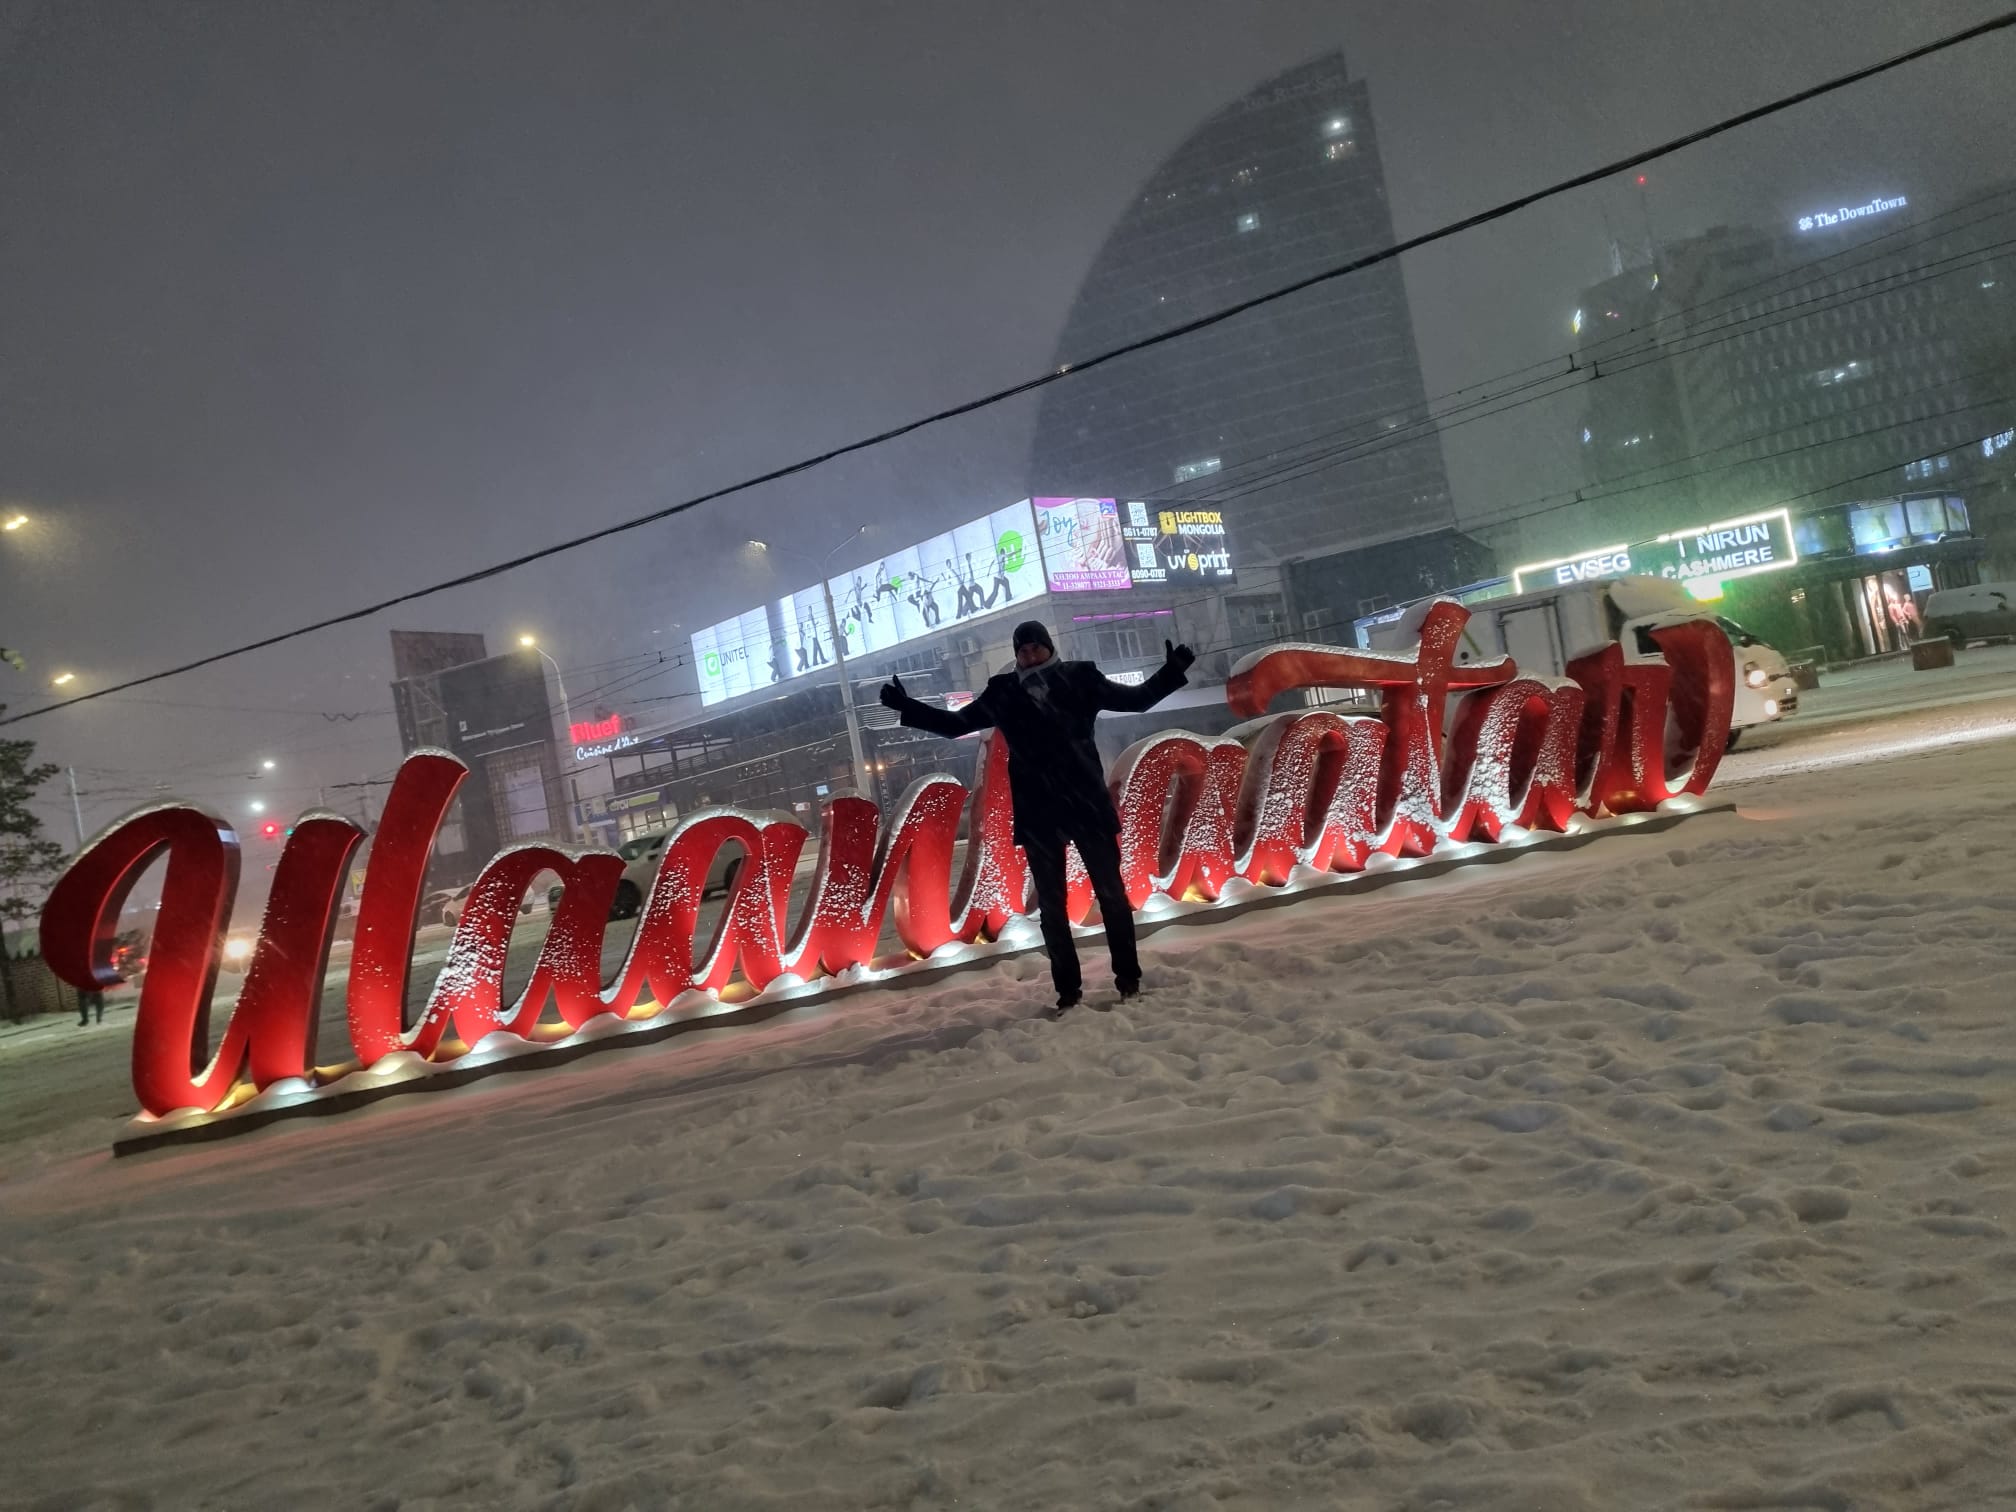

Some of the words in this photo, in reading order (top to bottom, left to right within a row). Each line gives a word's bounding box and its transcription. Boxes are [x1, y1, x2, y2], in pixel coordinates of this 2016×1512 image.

[1815, 213, 1838, 227] The
[1838, 196, 1907, 221] DownTown
[1040, 510, 1078, 547] Joy
[1175, 511, 1223, 524] LIGHTBOX
[1178, 524, 1226, 535] MONGOLIA
[1697, 522, 1770, 553] NIRUN
[1556, 552, 1632, 585] EVSEG
[1662, 545, 1774, 580] CASHMERE
[719, 647, 750, 667] UNITEL
